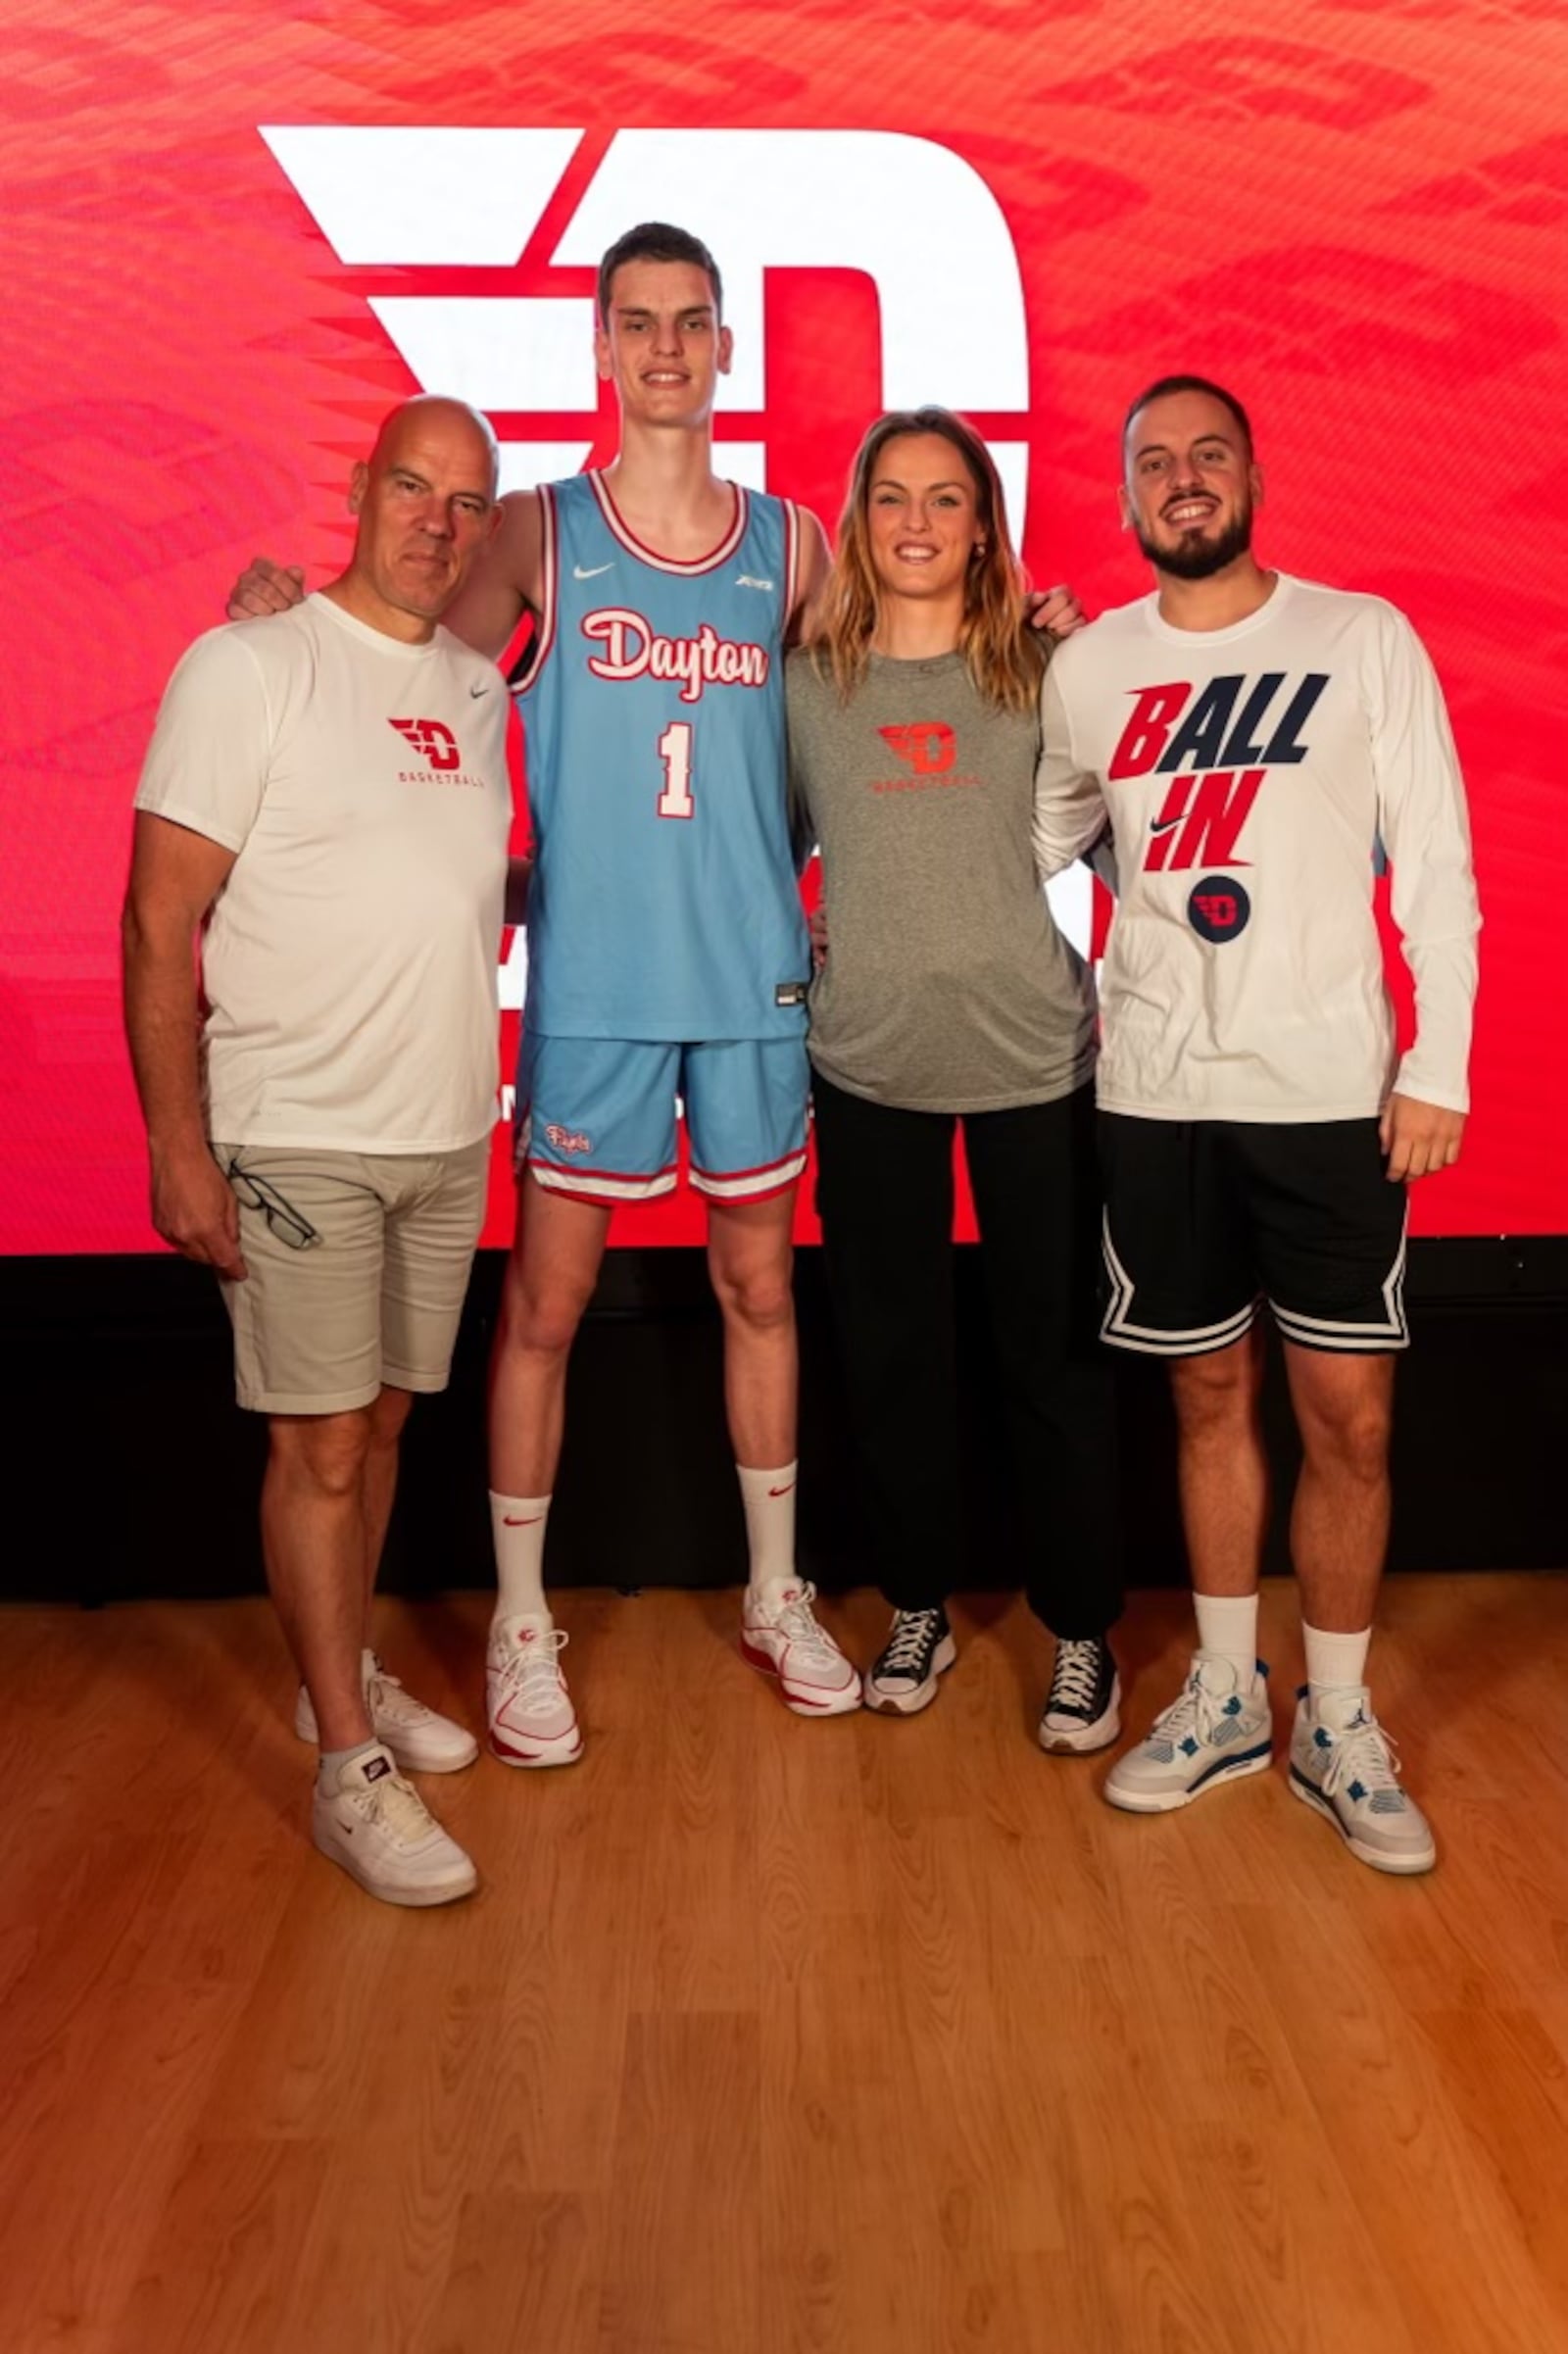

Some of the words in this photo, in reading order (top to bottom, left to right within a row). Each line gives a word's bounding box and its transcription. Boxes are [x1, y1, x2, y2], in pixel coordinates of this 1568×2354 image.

[581, 607, 769, 703] Dayton
[658, 721, 694, 818] 1
[1108, 672, 1331, 781] BALL
[398, 771, 485, 788] BASKETBALL
[1144, 768, 1268, 872] IN
